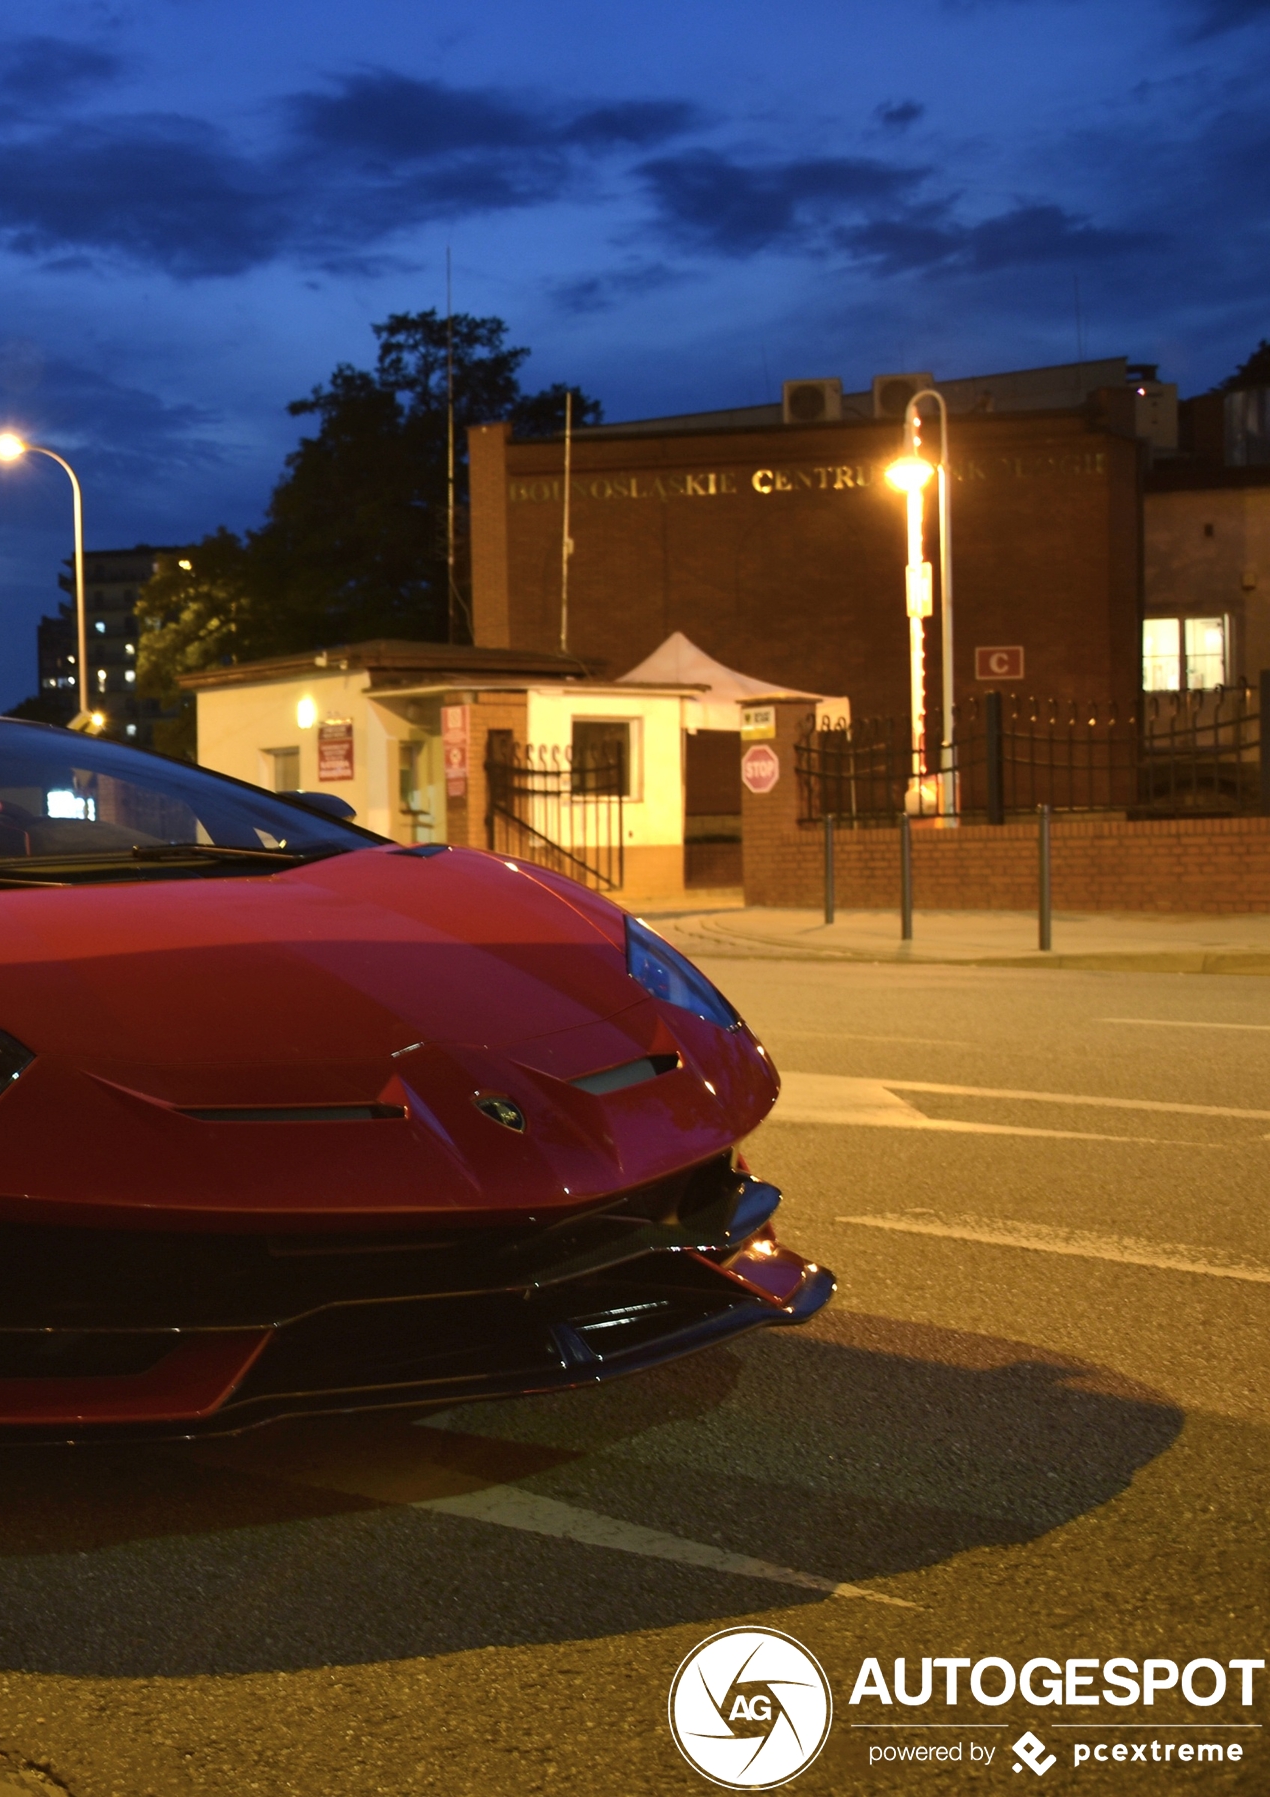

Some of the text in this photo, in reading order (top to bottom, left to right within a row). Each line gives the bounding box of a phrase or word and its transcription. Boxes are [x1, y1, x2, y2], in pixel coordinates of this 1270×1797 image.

[750, 465, 880, 494] CENTRU
[988, 652, 1009, 674] C
[745, 760, 775, 779] STOP
